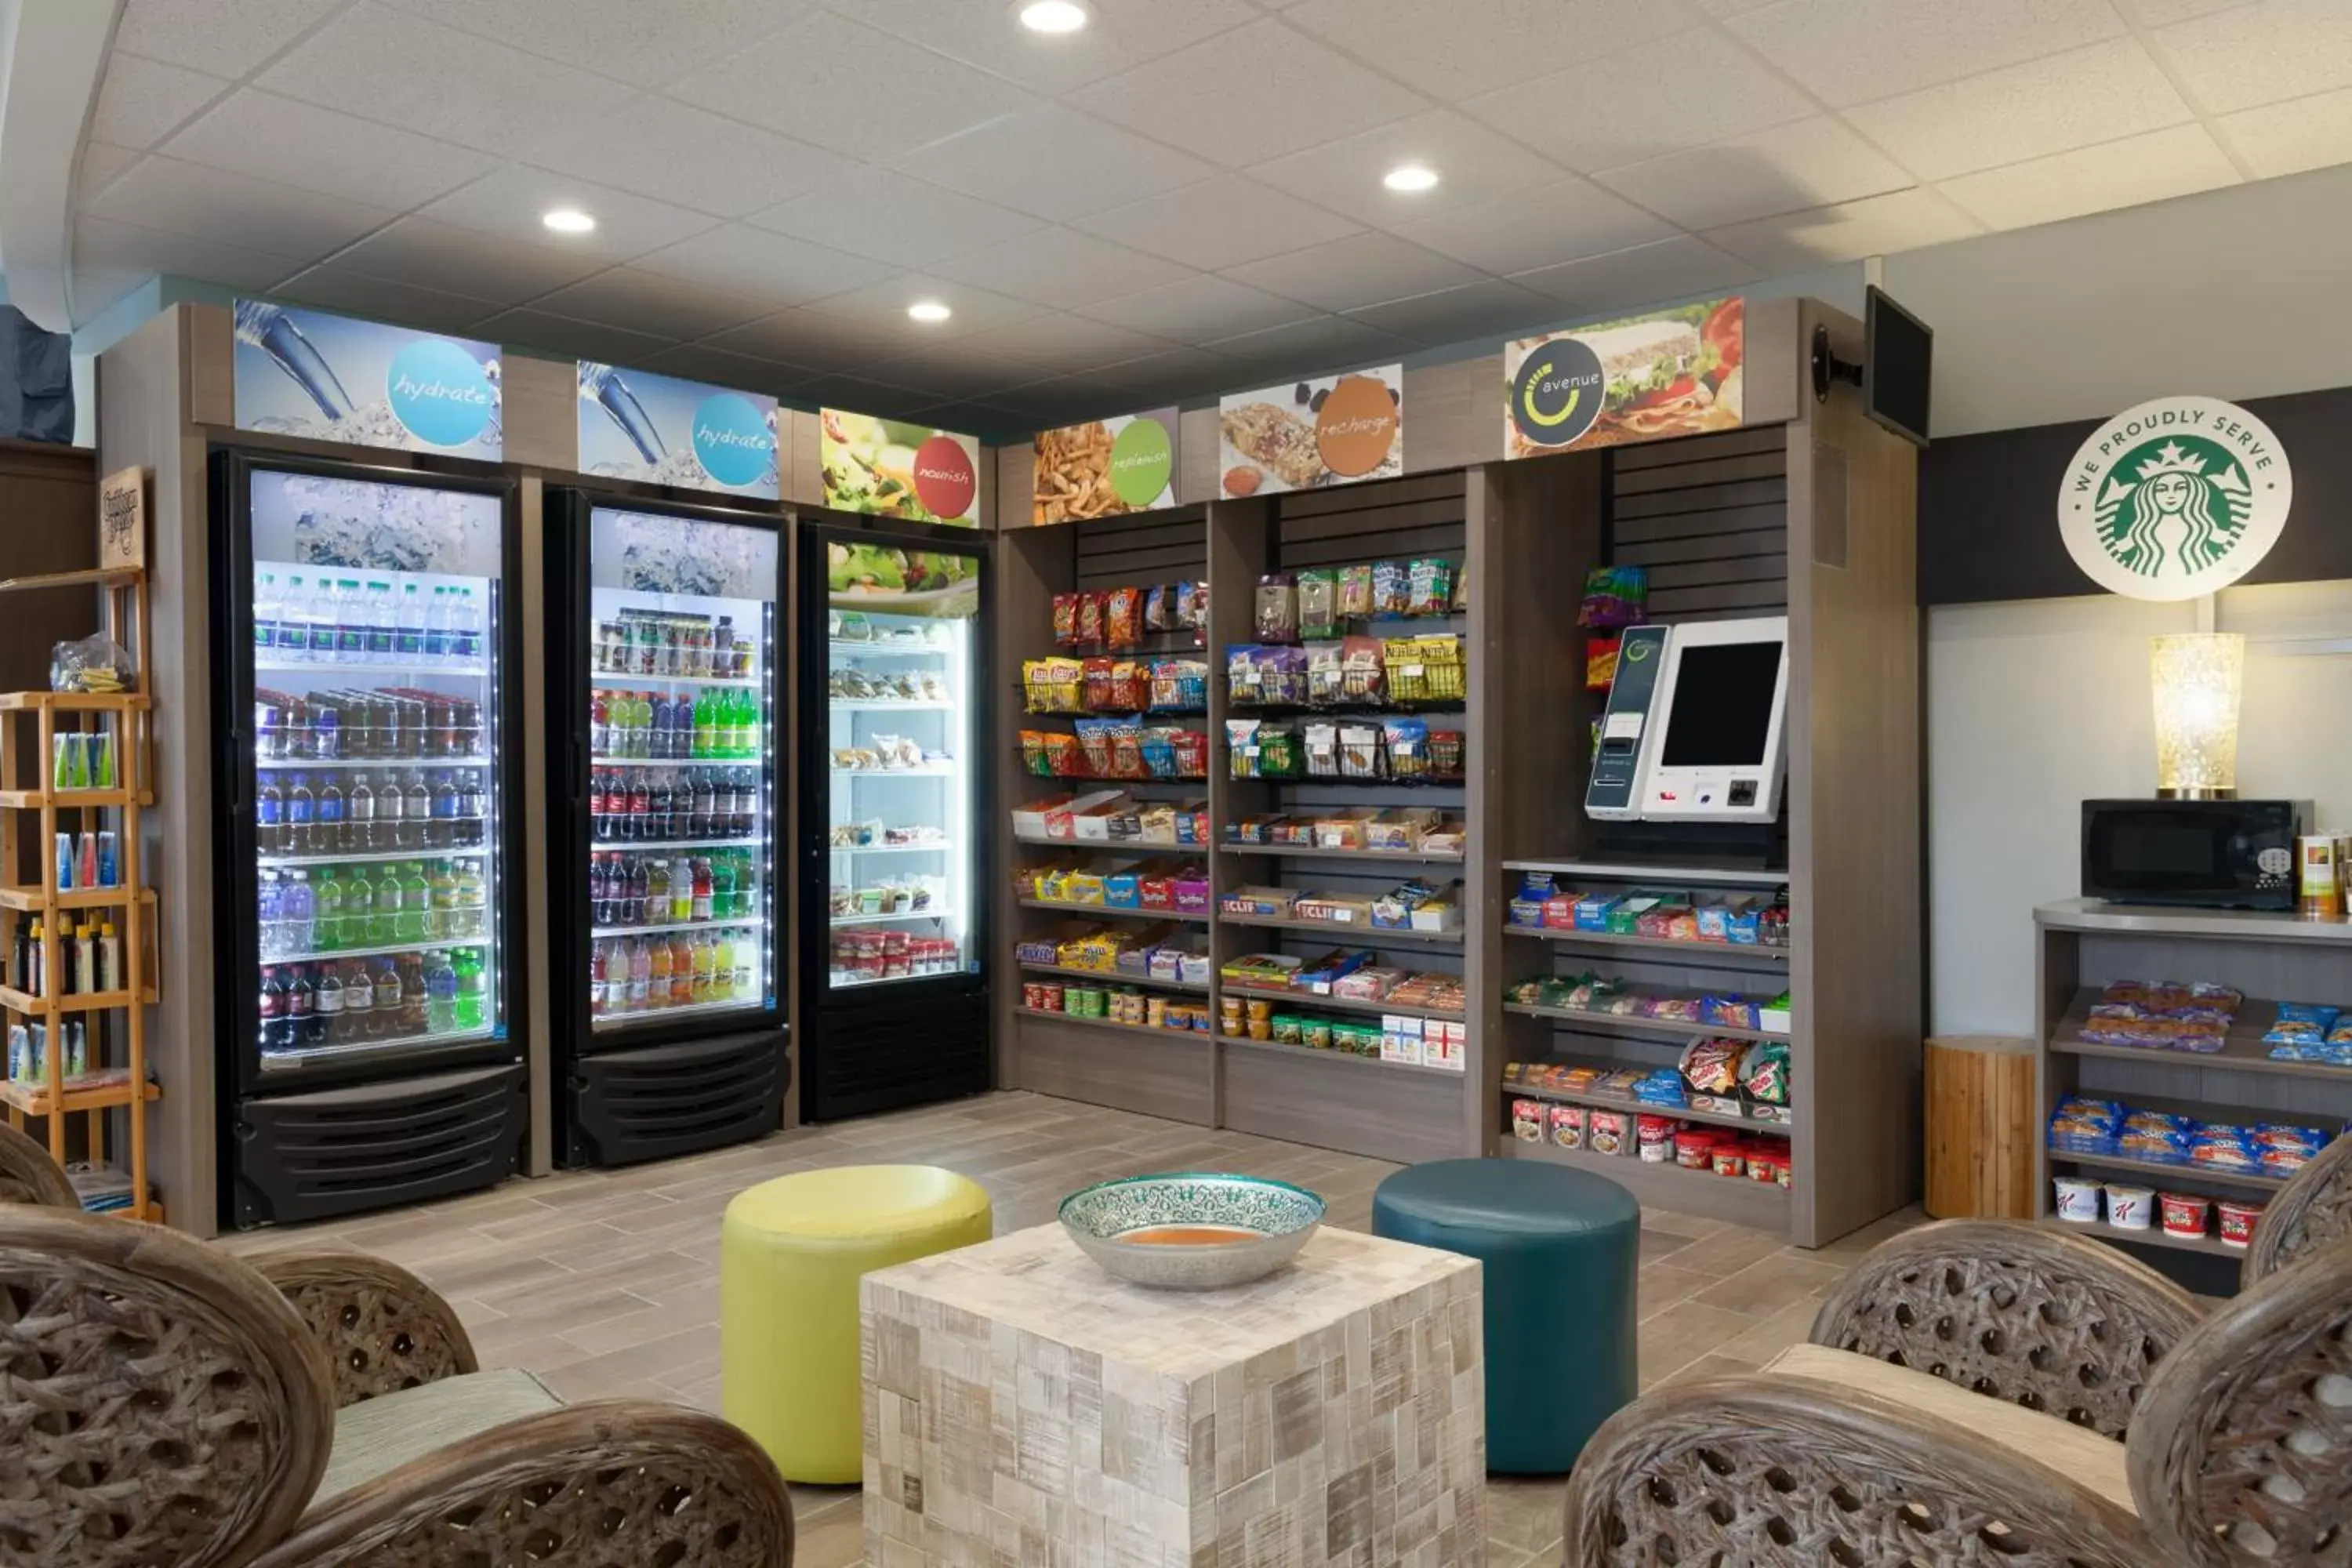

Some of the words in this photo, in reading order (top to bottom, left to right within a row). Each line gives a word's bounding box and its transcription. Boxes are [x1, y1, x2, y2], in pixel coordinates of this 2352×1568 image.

[394, 373, 487, 405] hydrate
[1542, 373, 1599, 394] avenue
[696, 423, 768, 450] hydrate
[1319, 416, 1392, 437] recharge
[2074, 461, 2100, 492] WE
[2098, 409, 2205, 456] PROUDLY
[2212, 416, 2274, 472] SERVE
[919, 467, 969, 485] nourish
[1228, 900, 1256, 913] CLIF
